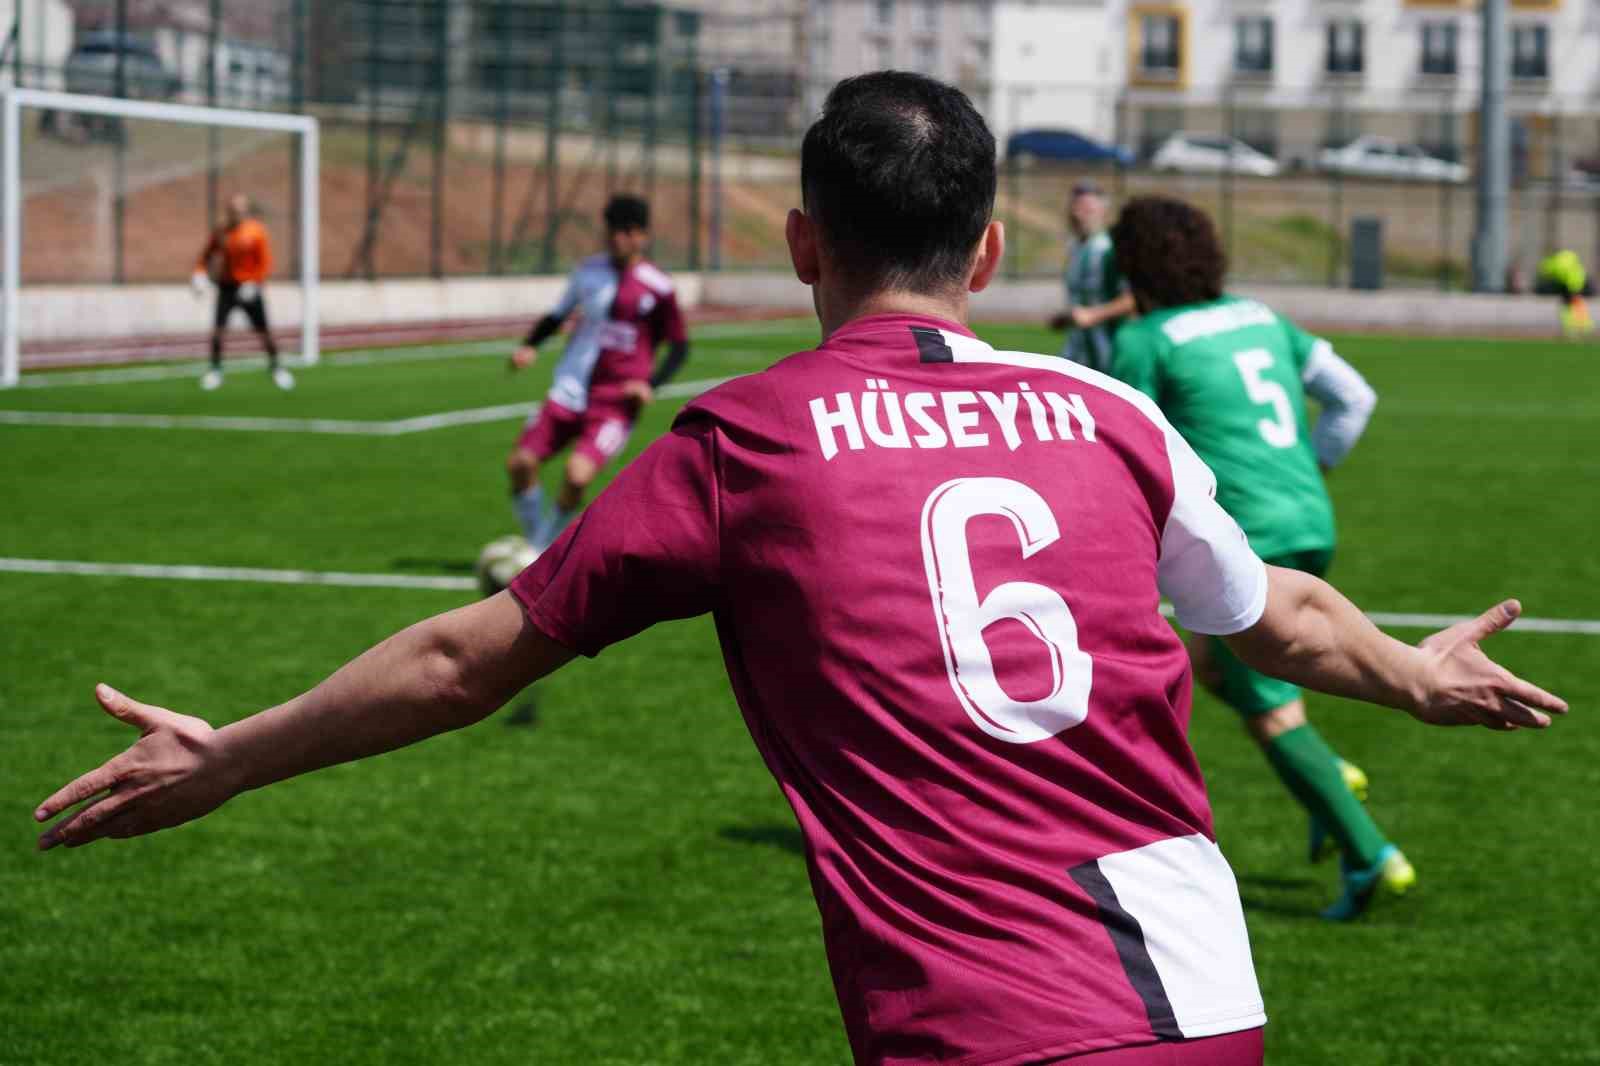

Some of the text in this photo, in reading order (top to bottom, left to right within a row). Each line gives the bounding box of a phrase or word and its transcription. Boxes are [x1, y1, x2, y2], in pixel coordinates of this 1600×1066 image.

[808, 378, 1097, 462] HÜSEYİN
[1233, 348, 1297, 448] 5
[920, 477, 1093, 744] 6
